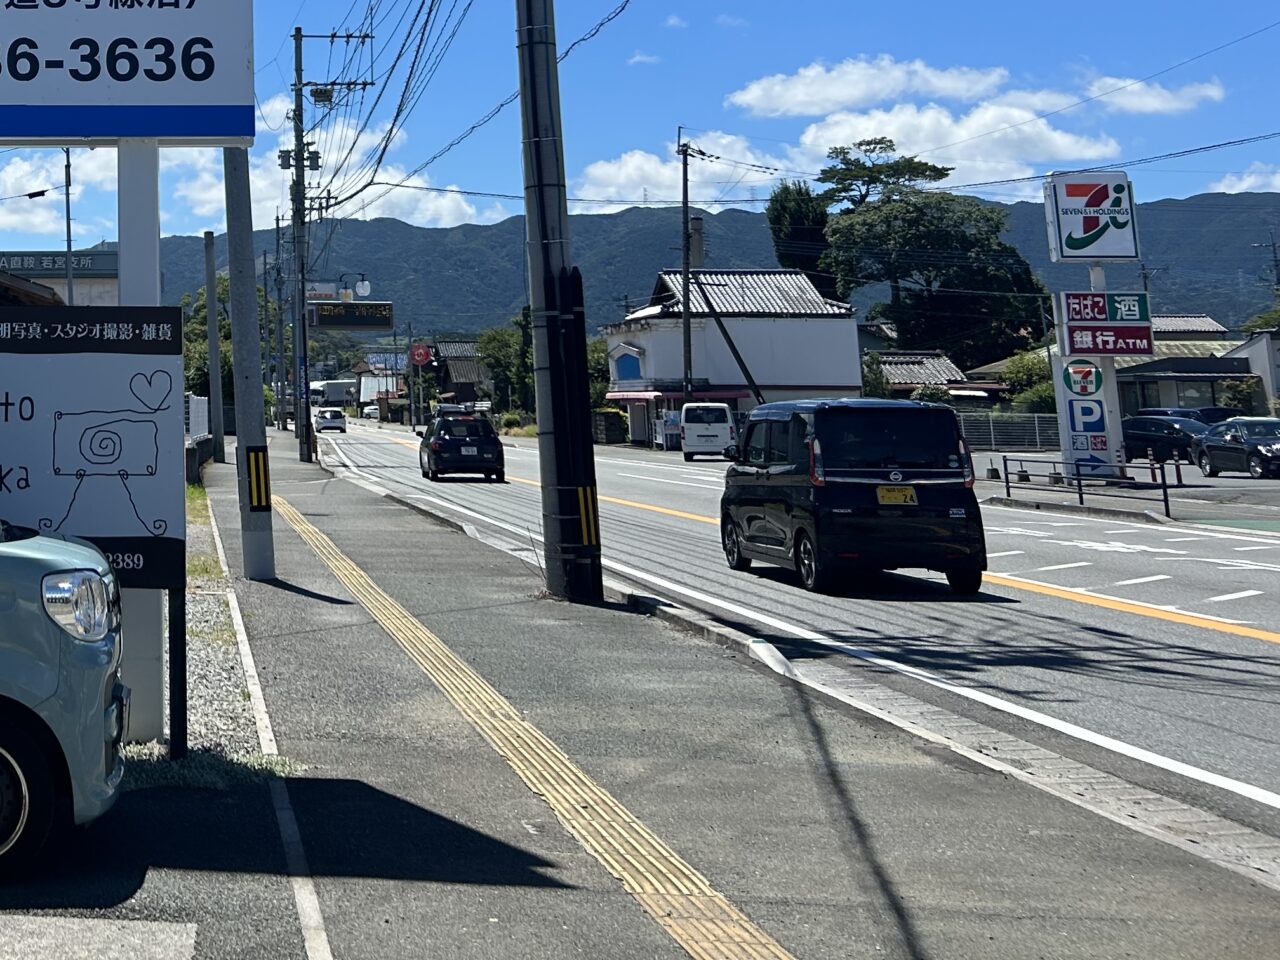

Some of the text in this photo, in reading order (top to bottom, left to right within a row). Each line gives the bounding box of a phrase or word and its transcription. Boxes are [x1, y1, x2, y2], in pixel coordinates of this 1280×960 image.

[1068, 295, 1106, 319] たばこ
[1114, 296, 1140, 320] 酒
[1072, 400, 1102, 431] P
